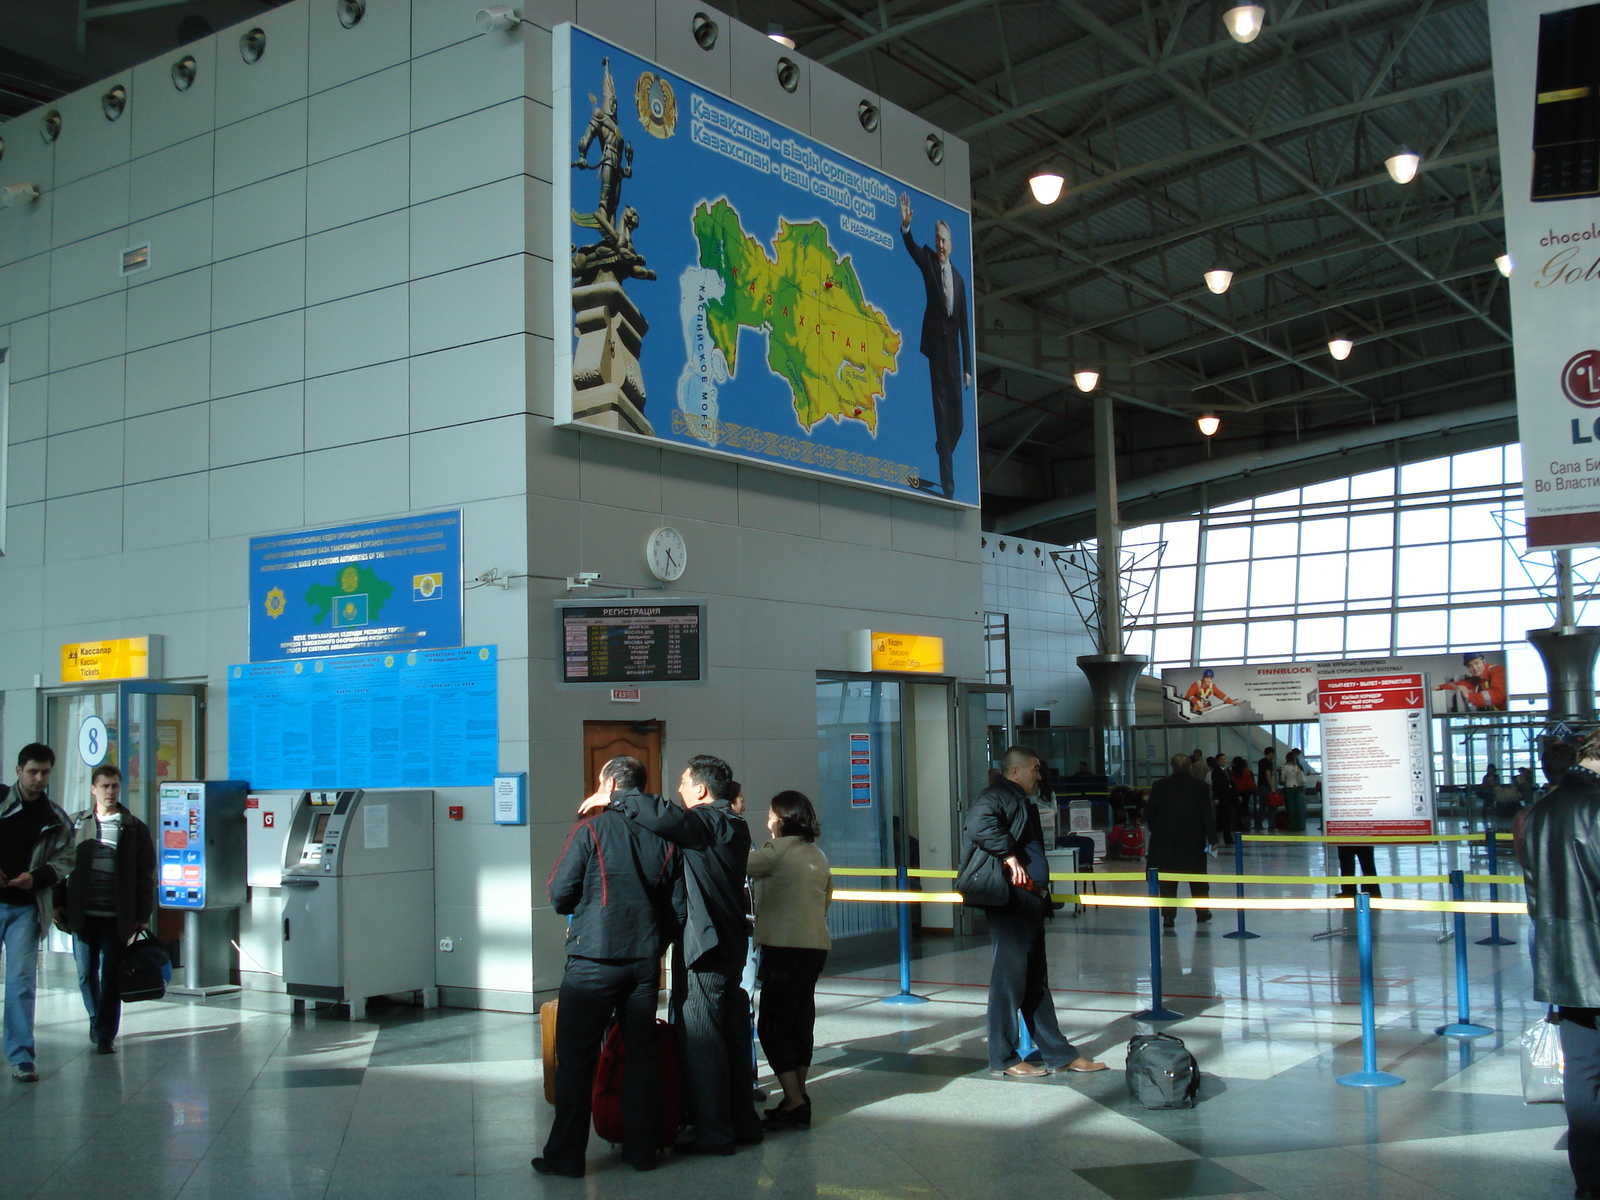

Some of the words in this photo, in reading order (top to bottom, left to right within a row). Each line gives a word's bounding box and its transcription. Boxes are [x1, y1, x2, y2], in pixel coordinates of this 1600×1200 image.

[691, 93, 770, 147] Қазақстан
[691, 120, 770, 173] Казахстан
[782, 166, 811, 191] наш
[811, 181, 850, 208] общий
[852, 198, 876, 220] дом
[850, 220, 893, 249] НАЗАРБАЕВ
[1540, 222, 1600, 247] chocol
[1533, 246, 1600, 289] Gol
[1550, 461, 1581, 475] Сапа
[1535, 479, 1551, 492] Во
[318, 556, 339, 566] CUSTOMS
[340, 553, 368, 563] AUTHORITIES
[368, 552, 375, 560] OF
[376, 551, 385, 559] THE
[603, 608, 661, 616] РЕГИСТРАЦИЯ
[888, 638, 903, 646] Кеден
[80, 647, 111, 655] Кассалар
[889, 658, 906, 666] Custom
[907, 658, 920, 667] Office
[81, 668, 99, 676] Tickets
[1257, 667, 1312, 675] FINNBLOCK
[89, 728, 98, 754] 8
